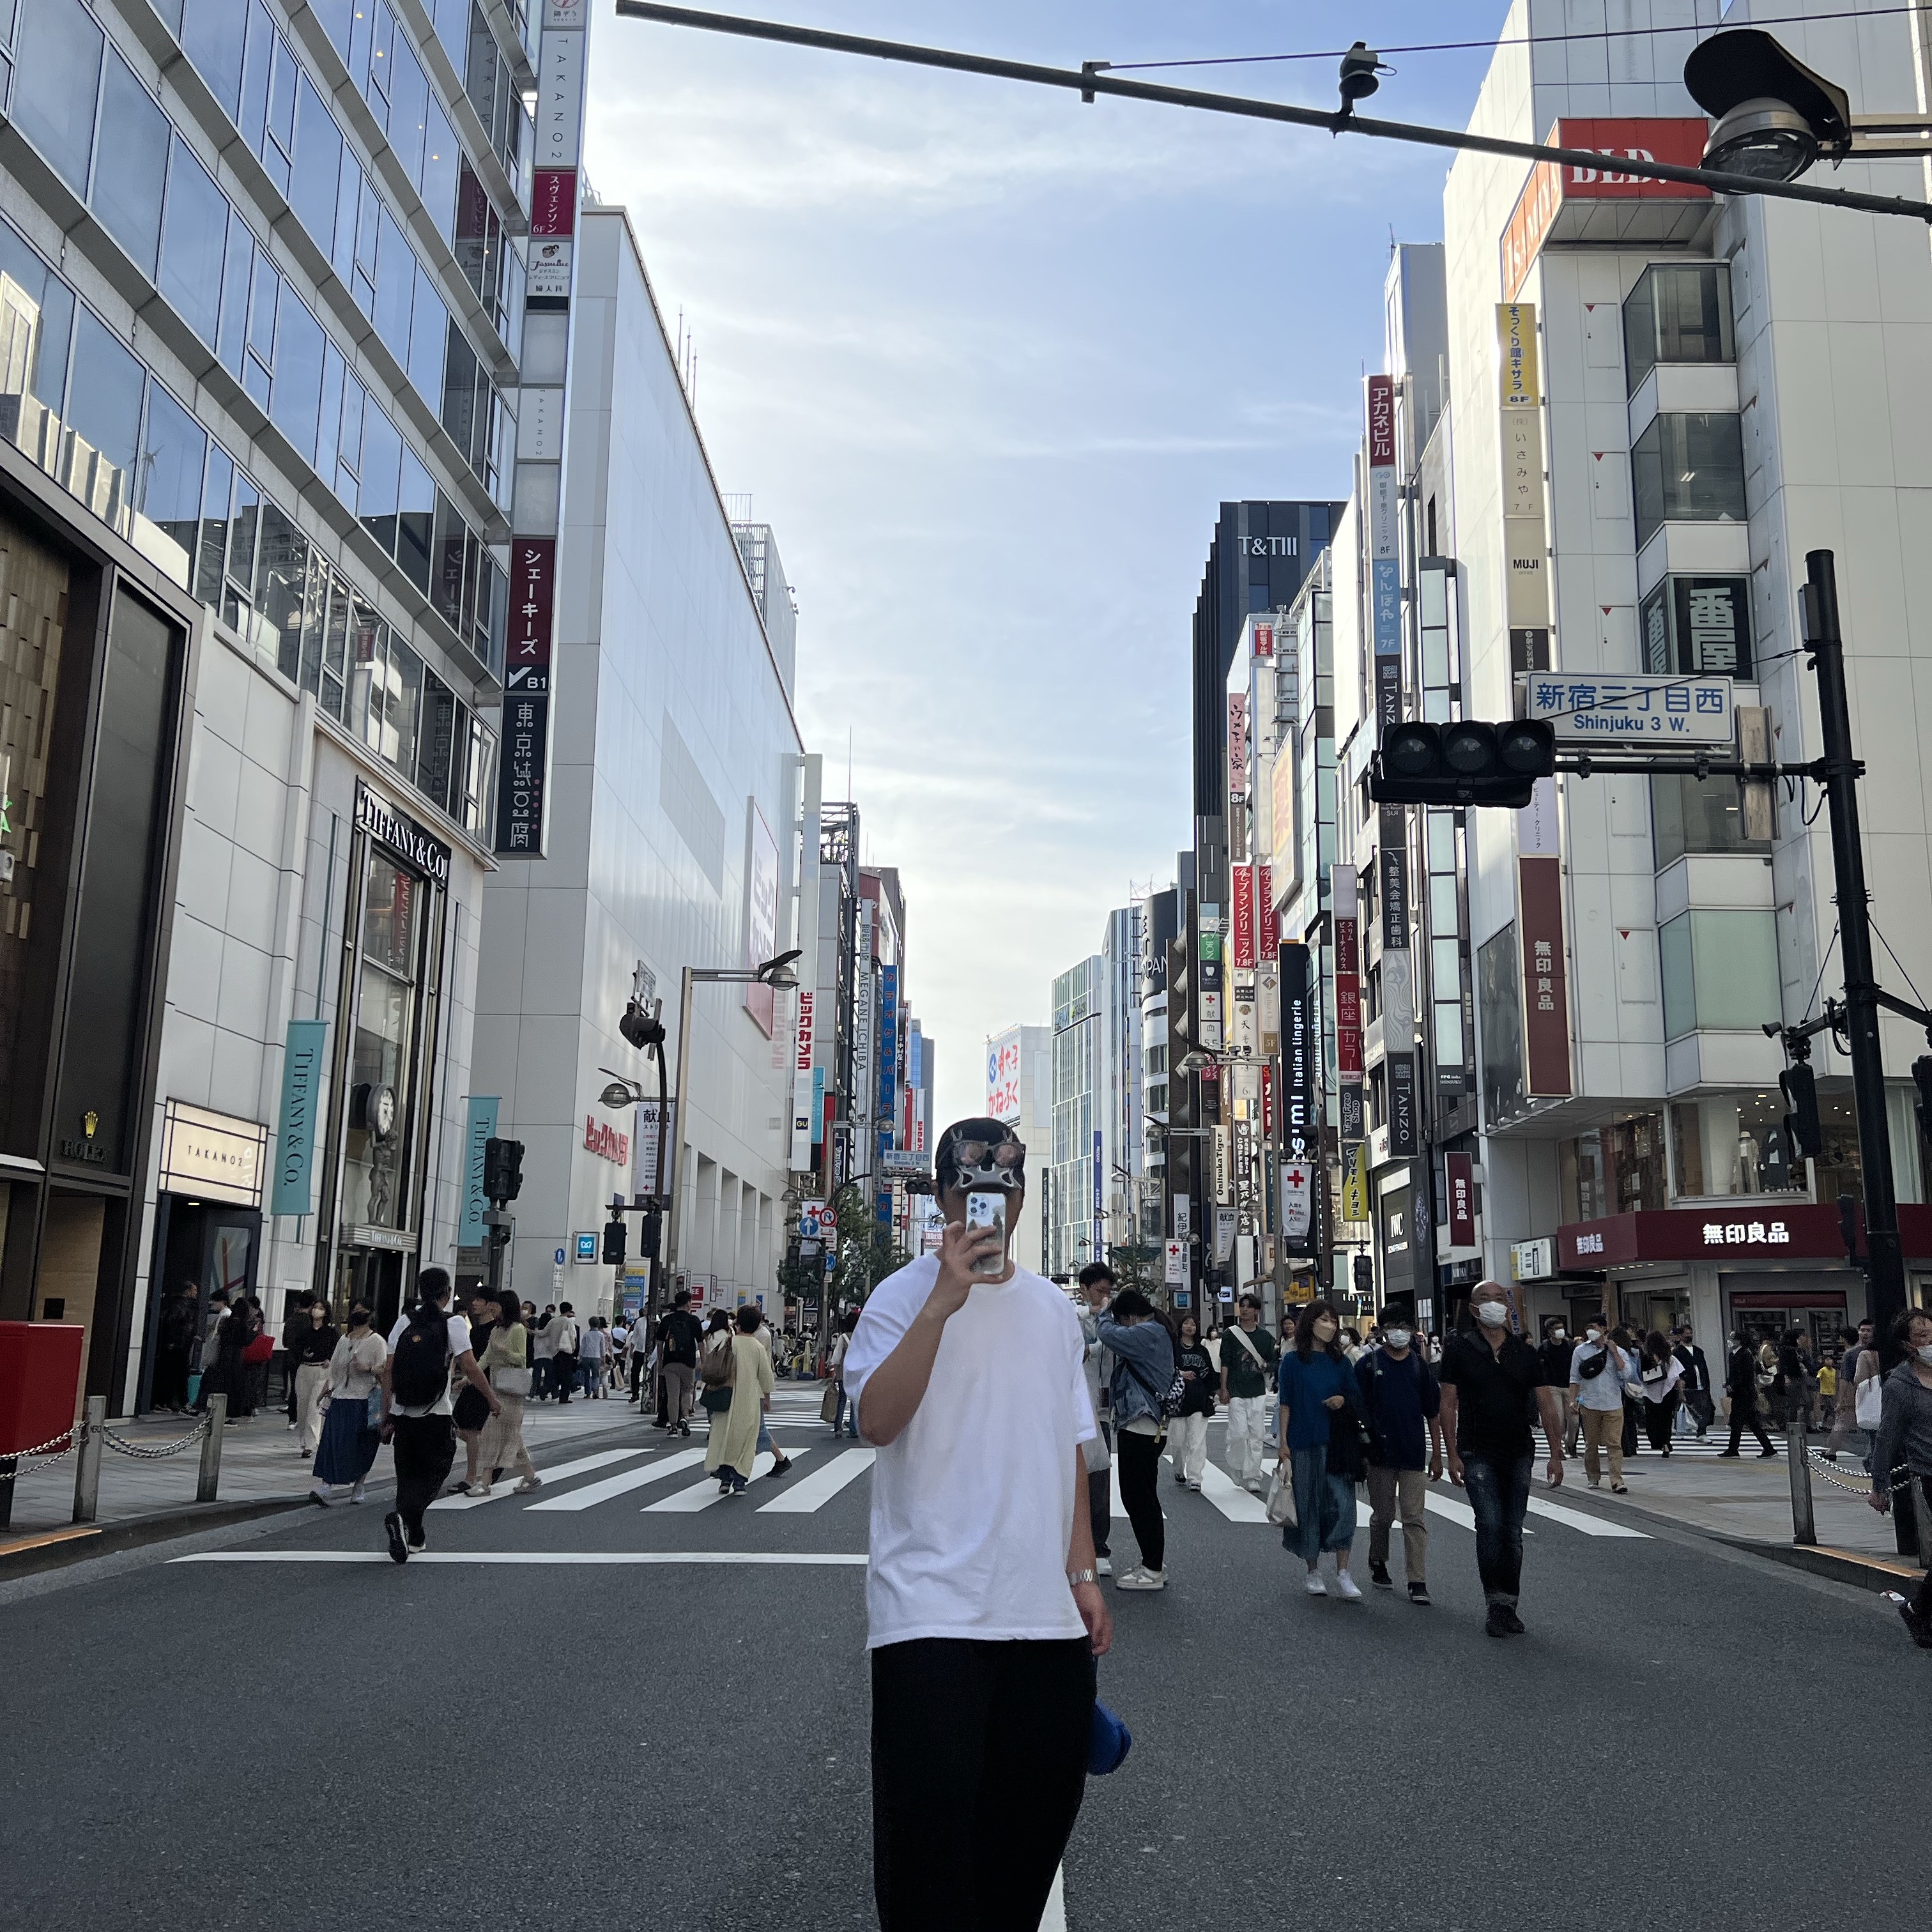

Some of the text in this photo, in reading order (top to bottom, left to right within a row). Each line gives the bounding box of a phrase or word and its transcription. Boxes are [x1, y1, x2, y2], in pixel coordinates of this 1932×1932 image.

[1570, 148, 1667, 184] BLD.
[547, 176, 560, 233] スヴェンソン
[532, 224, 546, 233] 6F
[530, 259, 569, 271] Jasmine
[1373, 387, 1390, 457] アカネビル
[1515, 433, 1529, 495] いさみや
[1380, 546, 1391, 555] 8F
[1513, 559, 1538, 569] MUJI
[520, 549, 541, 655] シェーキーズ
[1378, 564, 1395, 622] なんぼや
[1381, 639, 1395, 648] 7F
[1689, 586, 1738, 671] 番屋
[526, 677, 546, 689] B1
[1535, 682, 1724, 714] 新宿三丁目西
[1384, 681, 1398, 725] TANZ
[1574, 714, 1690, 733] Shinjuku 3 W.
[1230, 793, 1245, 803] 8F
[1238, 880, 1250, 959] ブランクリニック
[1388, 866, 1402, 947] 整美会矯正歯科
[1236, 958, 1254, 967] 7.8F
[1534, 940, 1554, 1011] 無印良品
[858, 971, 869, 1023] MEGANE
[857, 1028, 868, 1071] ICHIBA
[1265, 1039, 1275, 1048] 5F
[1291, 999, 1305, 1087] Italian lingerie
[287, 1048, 314, 1130] TIFFANY
[1343, 1092, 1353, 1133] Tax Free
[1352, 1100, 1361, 1124] Shop
[187, 1144, 243, 1167] TAKANO2
[886, 1153, 930, 1162] 新宿三丁目西
[1455, 1178, 1468, 1220] 無印良品
[1219, 1213, 1234, 1222] 献血
[1390, 1212, 1404, 1238] IWC
[1702, 1222, 1790, 1245] 無印良品
[1575, 1233, 1604, 1256] 無印良品
